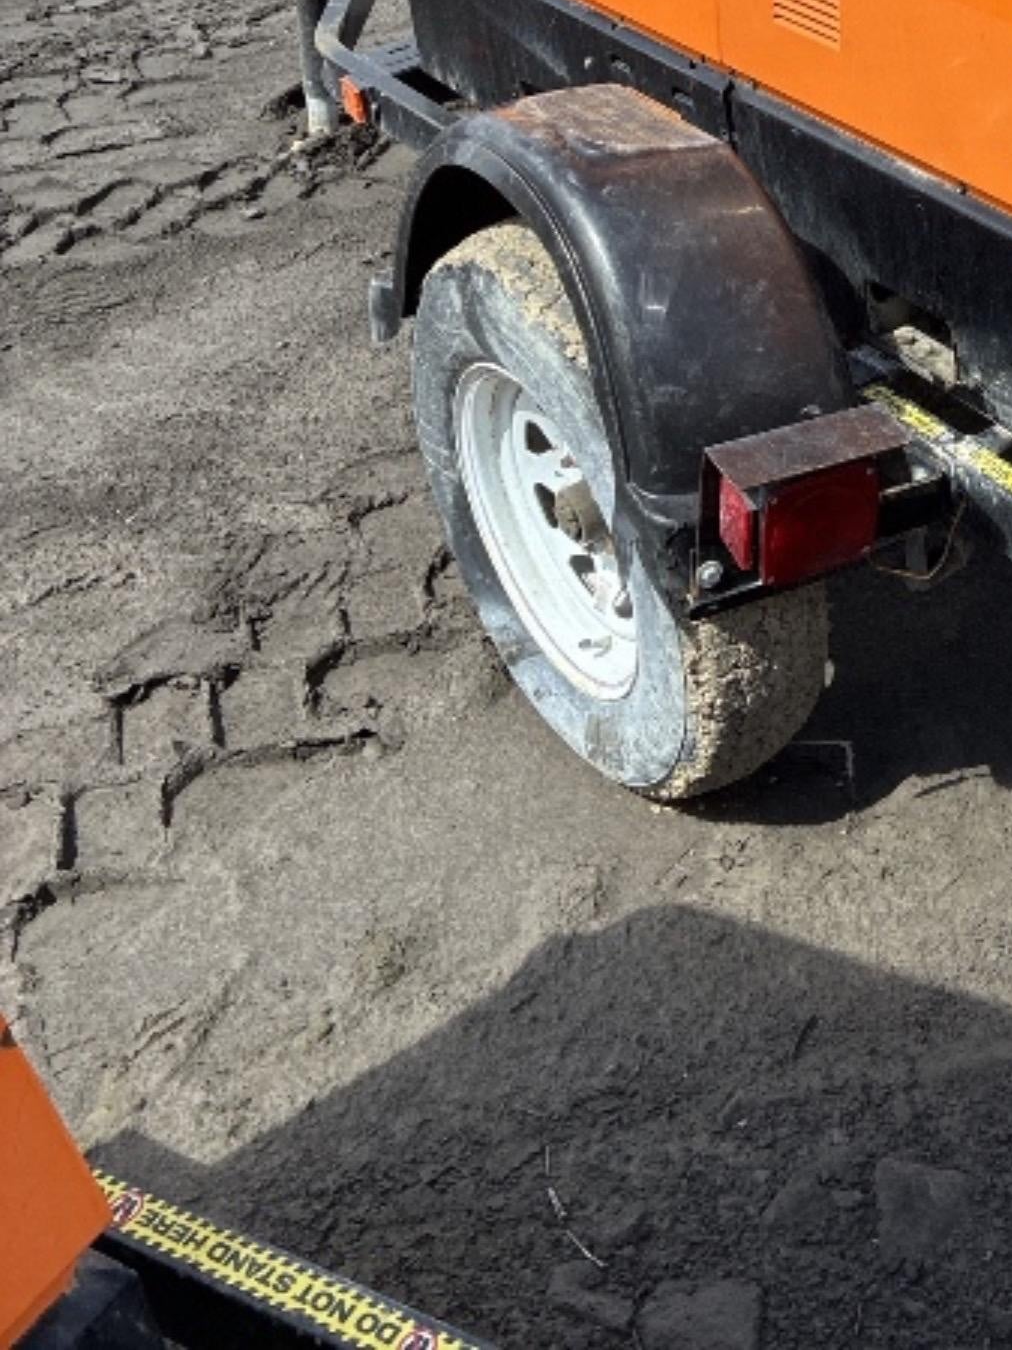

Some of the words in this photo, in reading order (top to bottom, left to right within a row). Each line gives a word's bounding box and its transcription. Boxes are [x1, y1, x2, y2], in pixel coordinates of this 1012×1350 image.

[139, 1210, 209, 1251] HERE
[207, 1240, 297, 1294] STAND
[299, 1283, 356, 1324] NOT
[355, 1312, 401, 1346] DO
